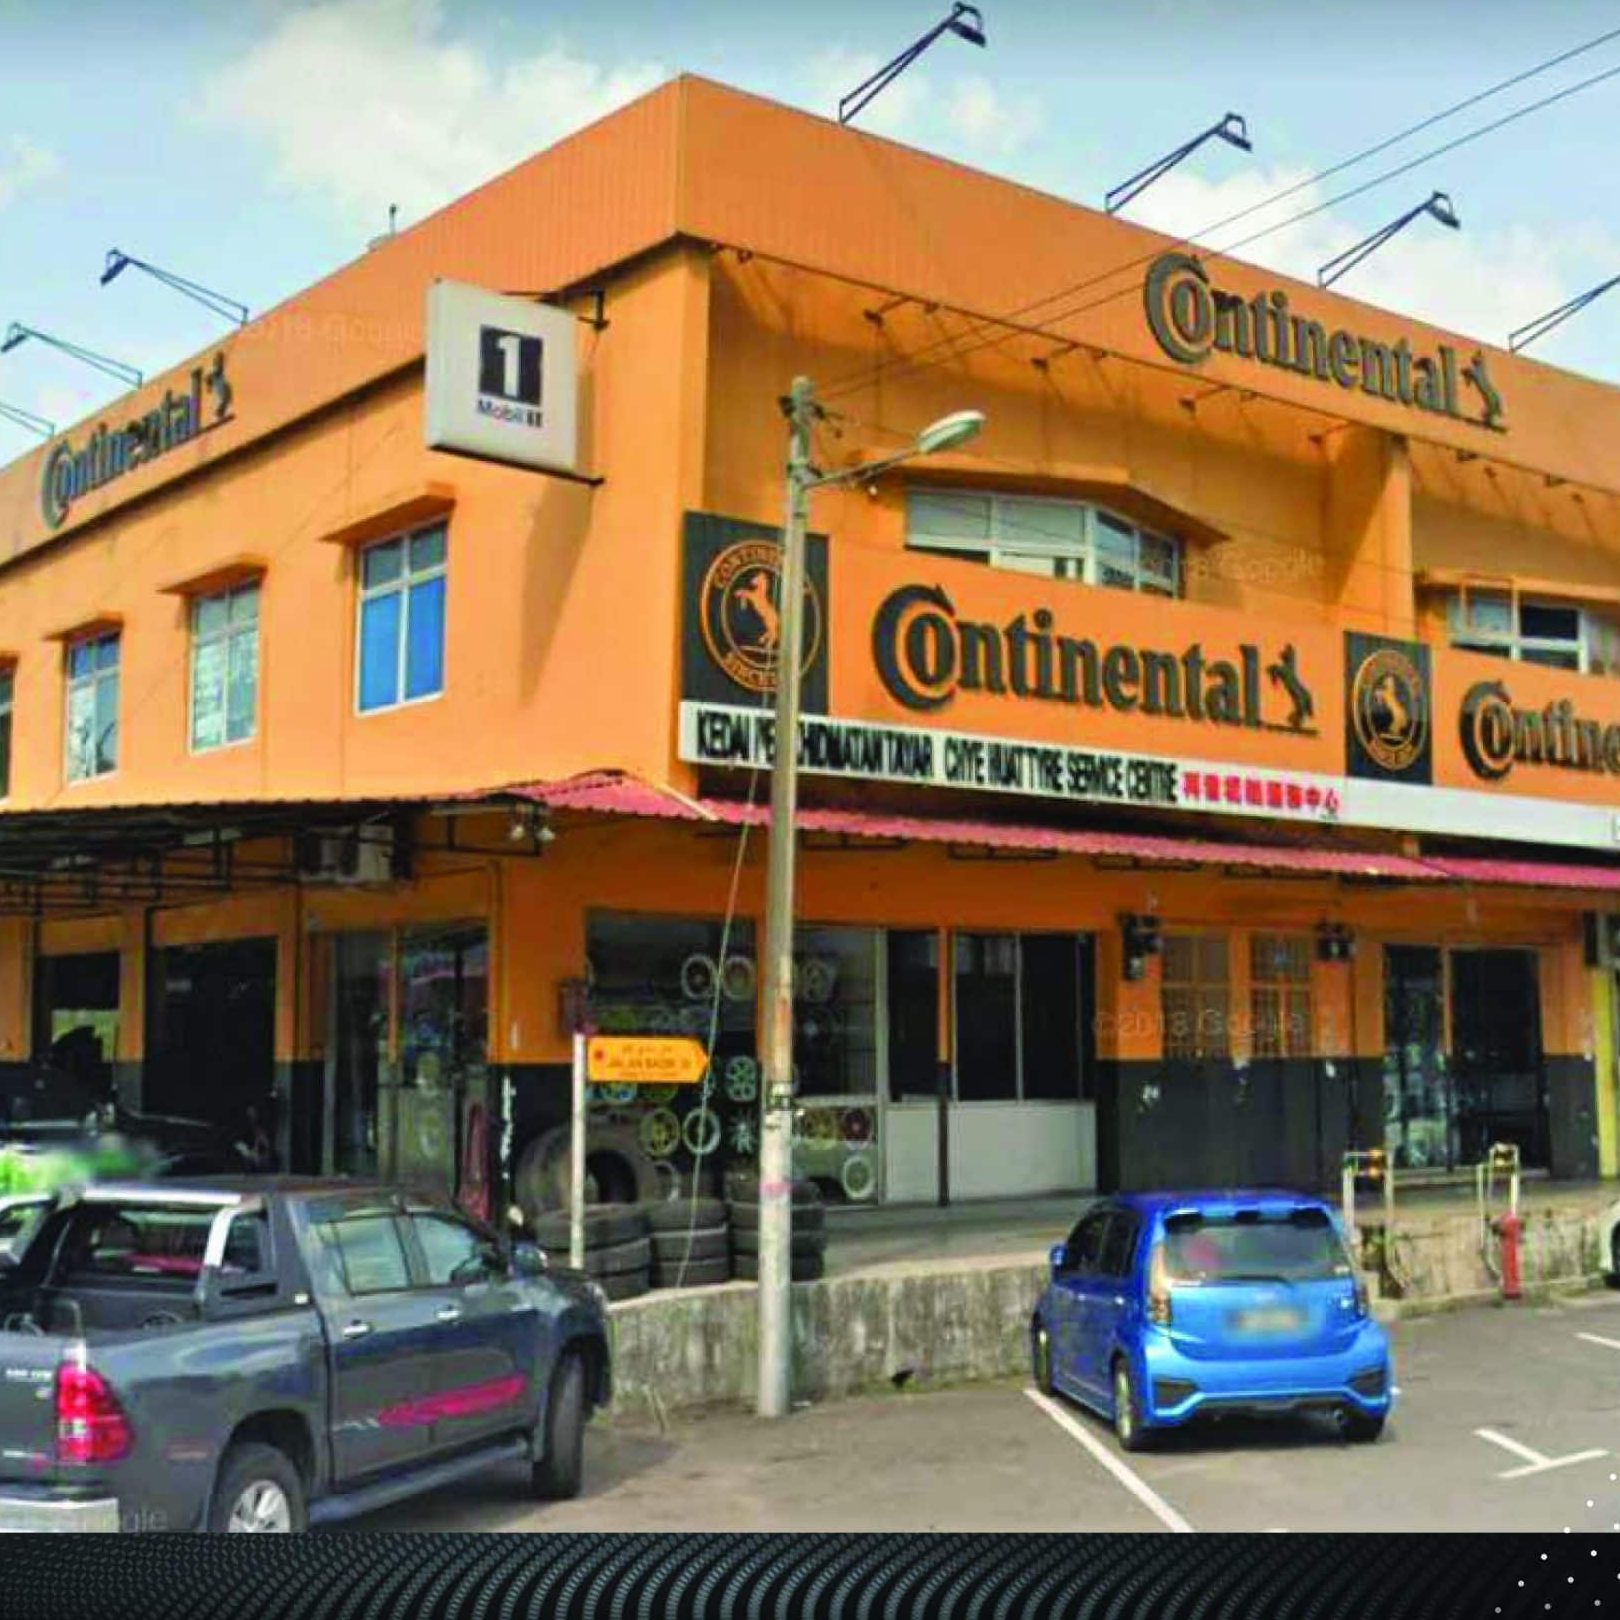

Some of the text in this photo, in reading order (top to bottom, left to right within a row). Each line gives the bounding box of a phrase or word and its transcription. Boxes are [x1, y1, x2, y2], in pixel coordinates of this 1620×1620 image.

[1144, 252, 1457, 418] Continental
[42, 366, 203, 530] Continental
[697, 707, 750, 760] KEDAI
[872, 583, 1264, 729] Continental
